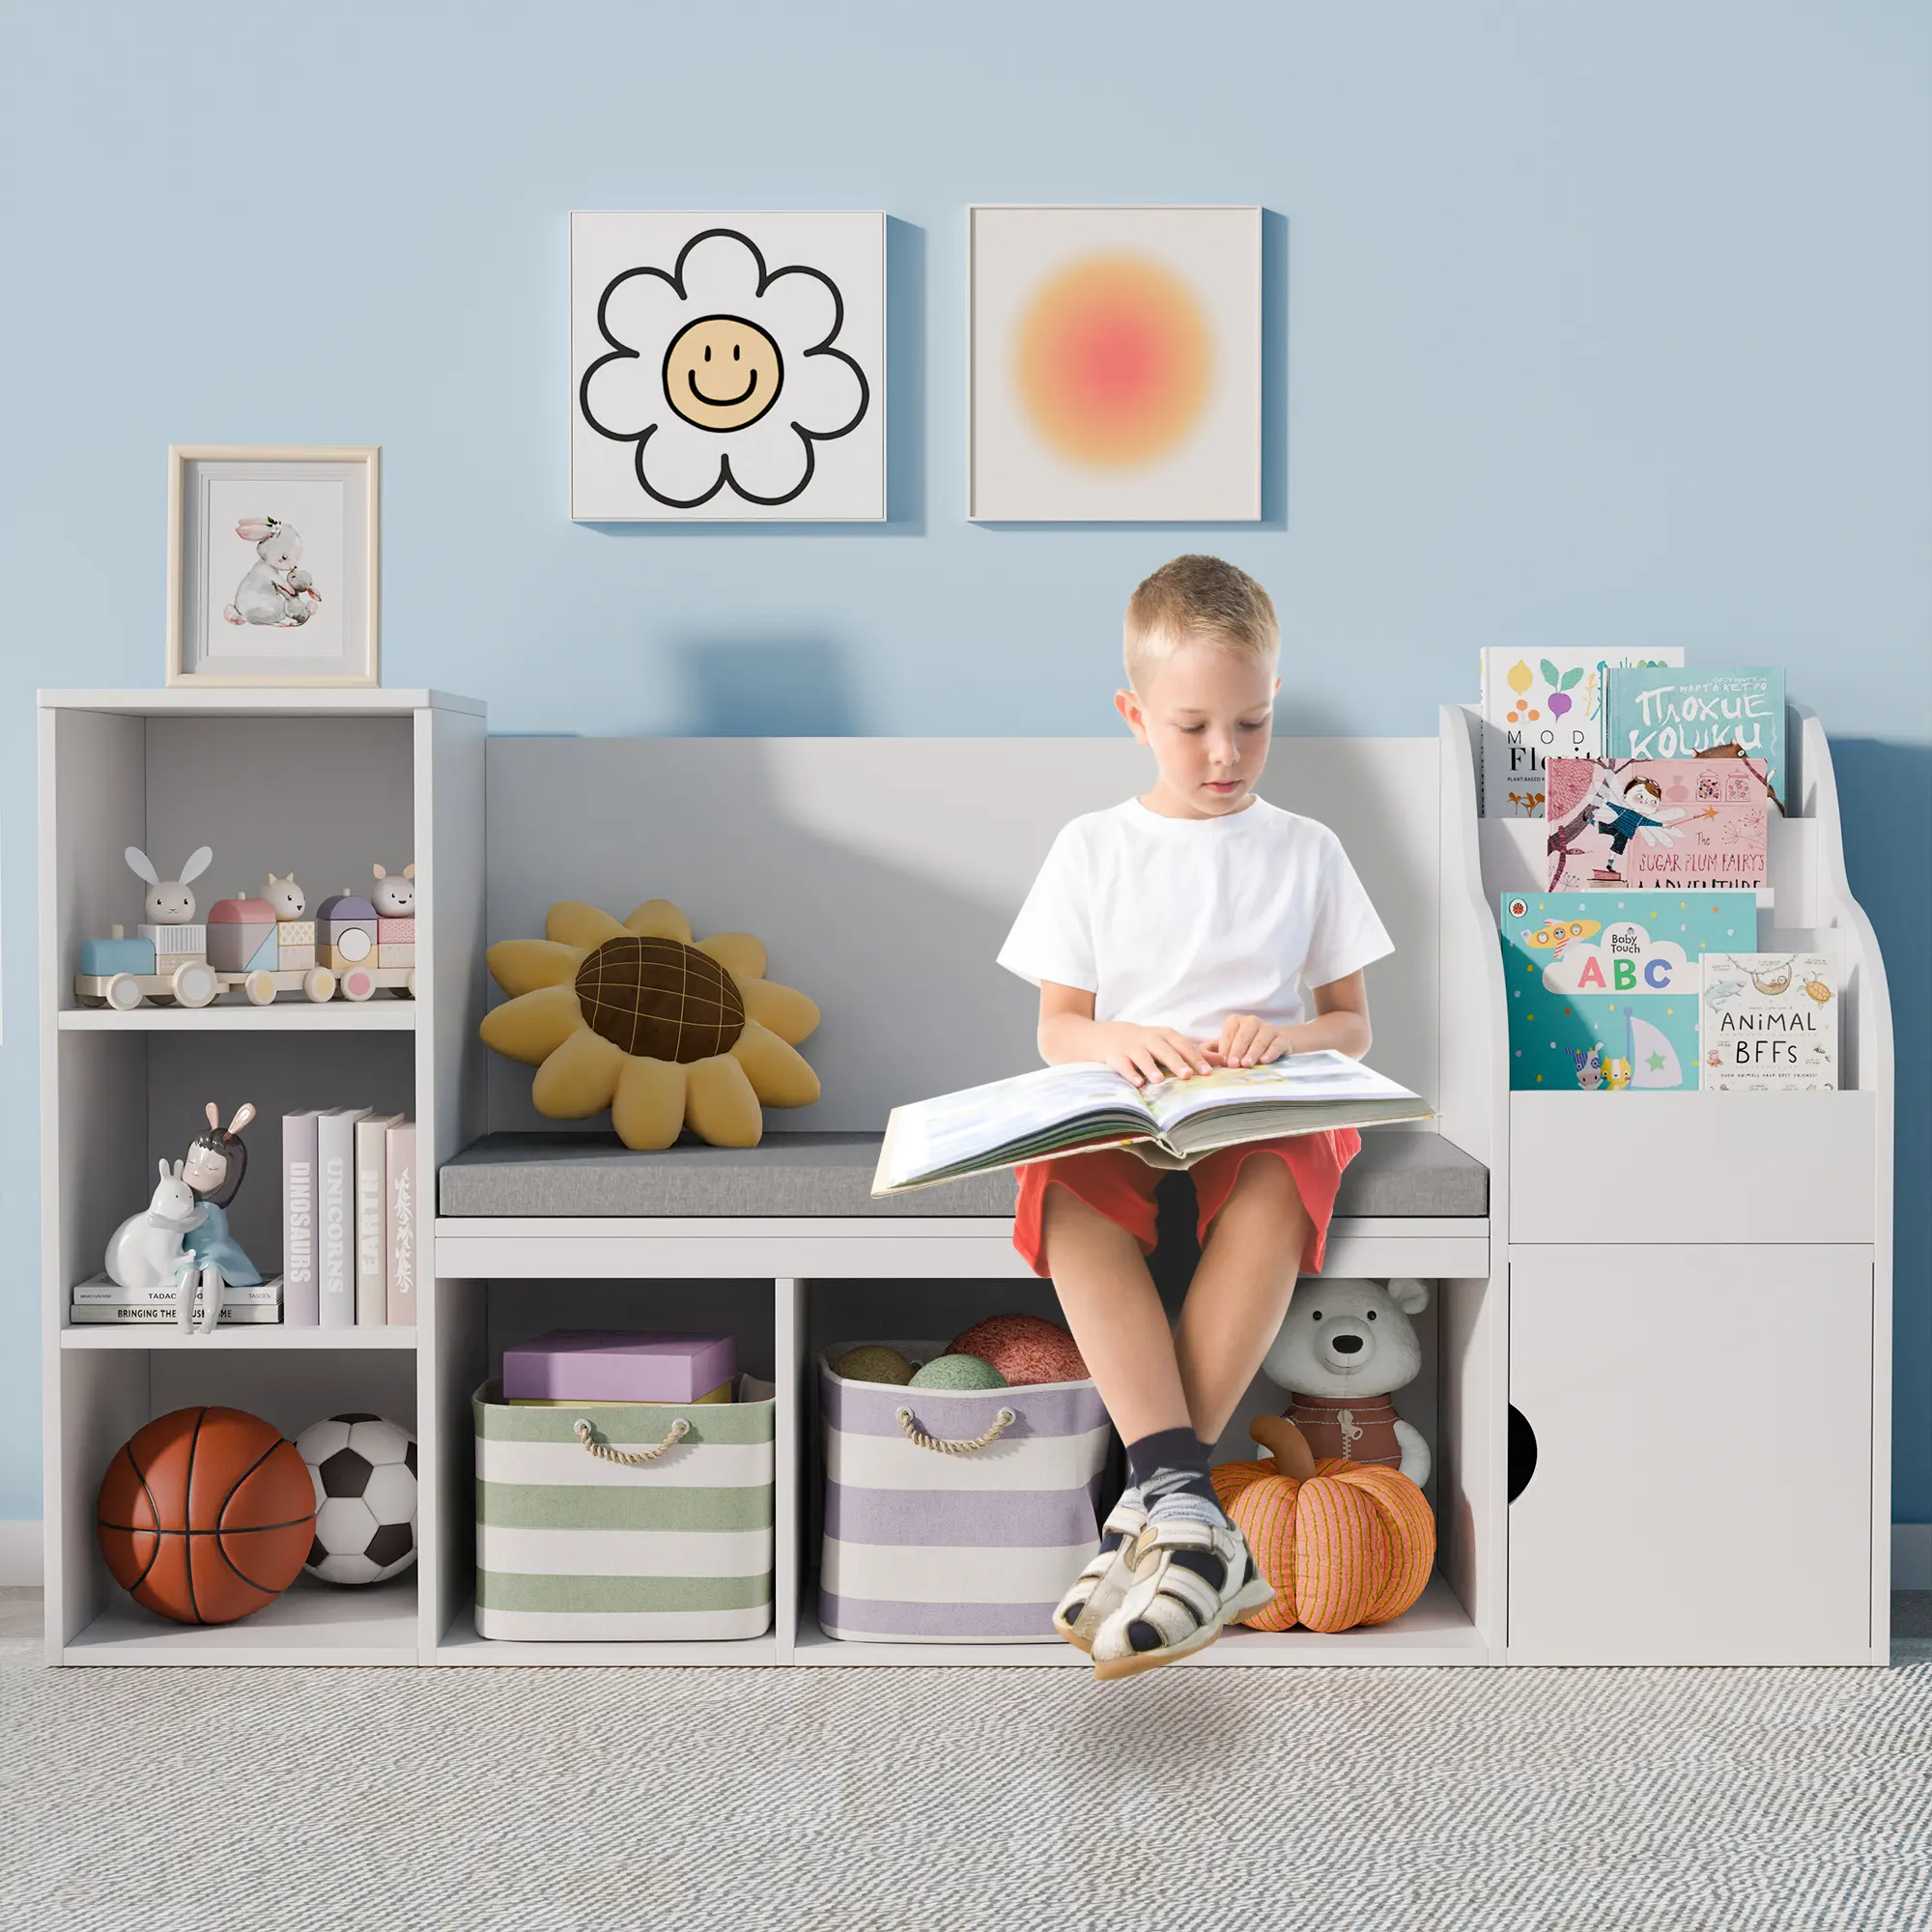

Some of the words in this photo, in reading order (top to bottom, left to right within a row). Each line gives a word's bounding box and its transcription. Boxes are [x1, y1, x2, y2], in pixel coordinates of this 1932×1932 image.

[1722, 682, 1768, 693] КЕТРО
[1695, 831, 1711, 846] The
[1638, 853, 1683, 872] SUGAR
[1685, 853, 1719, 872] PLUM
[1721, 853, 1765, 872] FAIRY'S
[1610, 943, 1641, 953] Touch
[1611, 933, 1637, 946] Baby
[1577, 955, 1673, 991] ABC
[290, 1161, 312, 1283] DINOSAURS
[327, 1156, 344, 1294] UNICORNS
[360, 1169, 380, 1275] EARTH
[117, 1309, 158, 1319] BRINGING
[160, 1309, 176, 1319] THE
